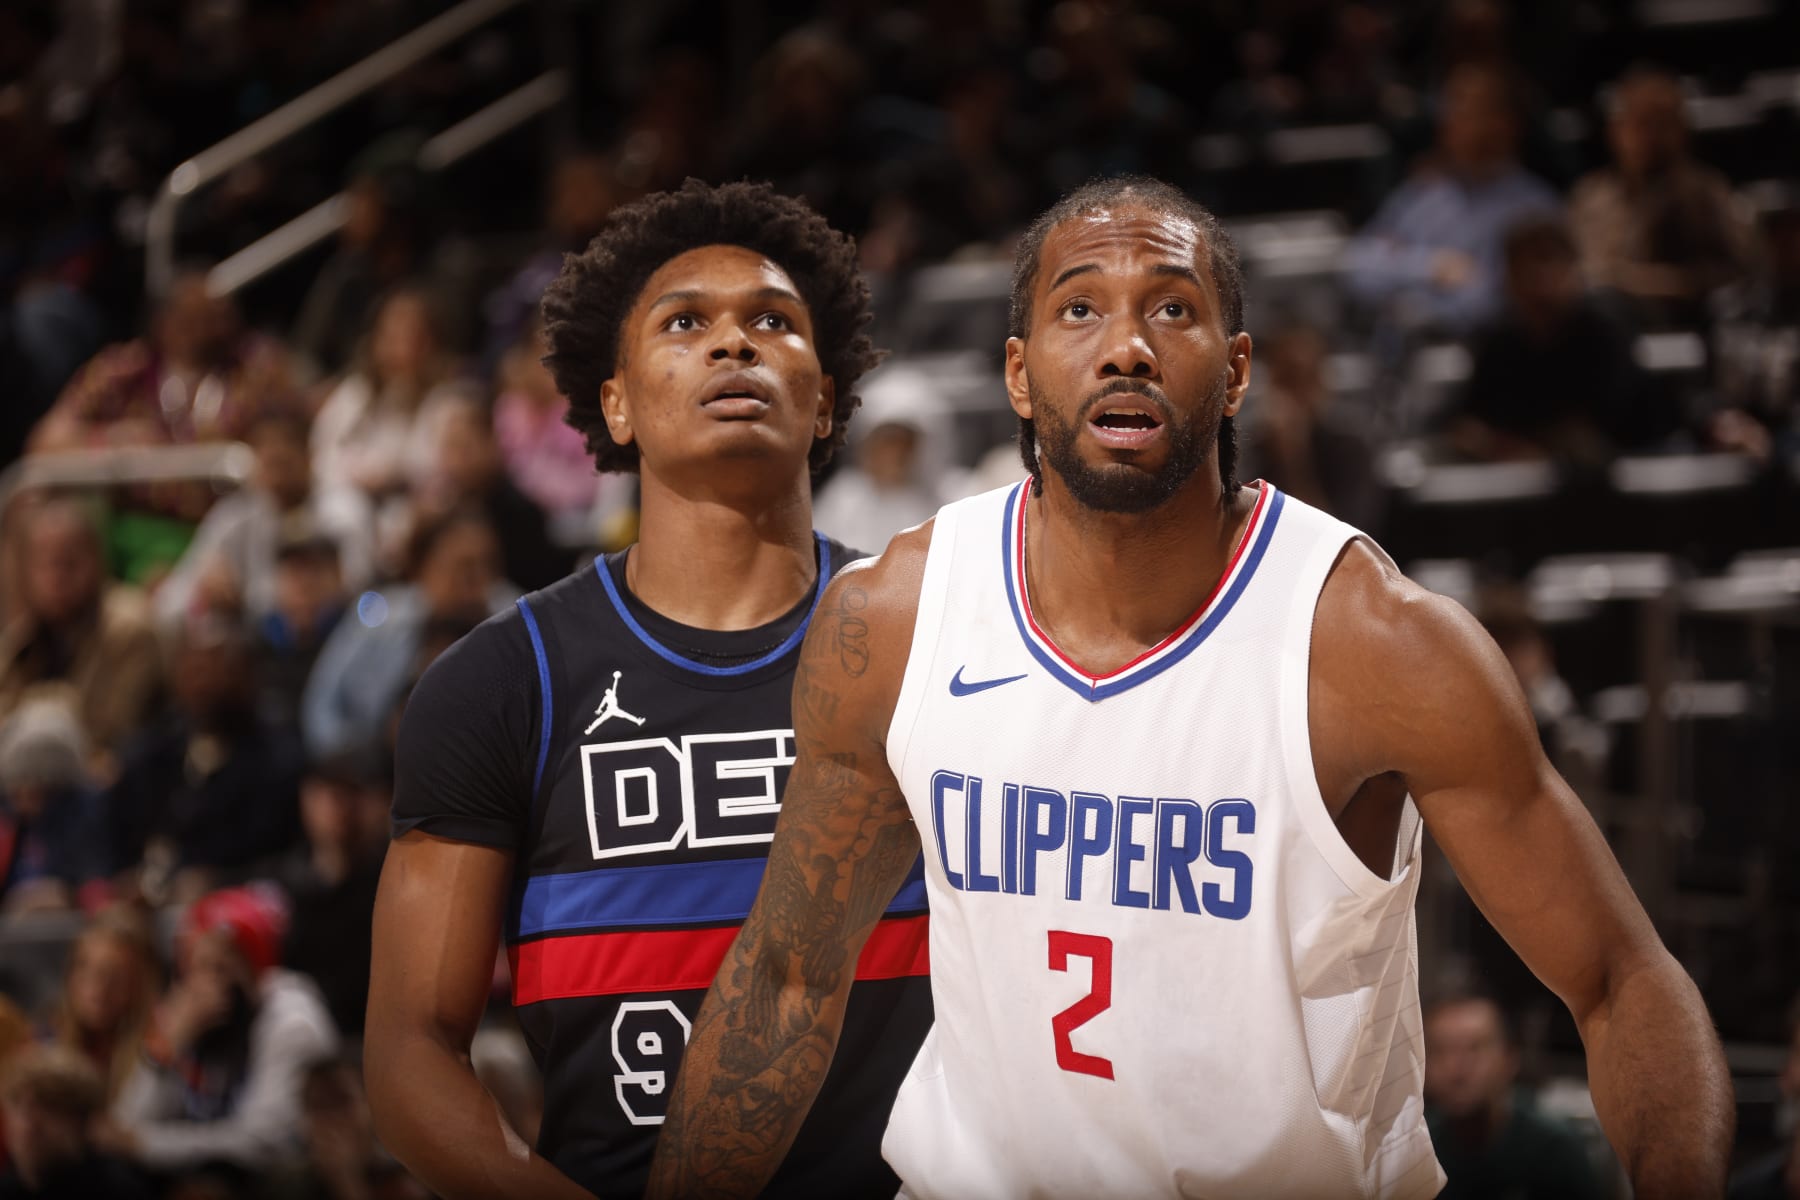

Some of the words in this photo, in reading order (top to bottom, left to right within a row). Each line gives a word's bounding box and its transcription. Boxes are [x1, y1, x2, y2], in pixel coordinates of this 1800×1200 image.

[580, 729, 797, 859] DE
[930, 769, 1256, 920] CLIPPERS
[611, 1000, 693, 1126] 9
[1047, 930, 1115, 1081] 2
